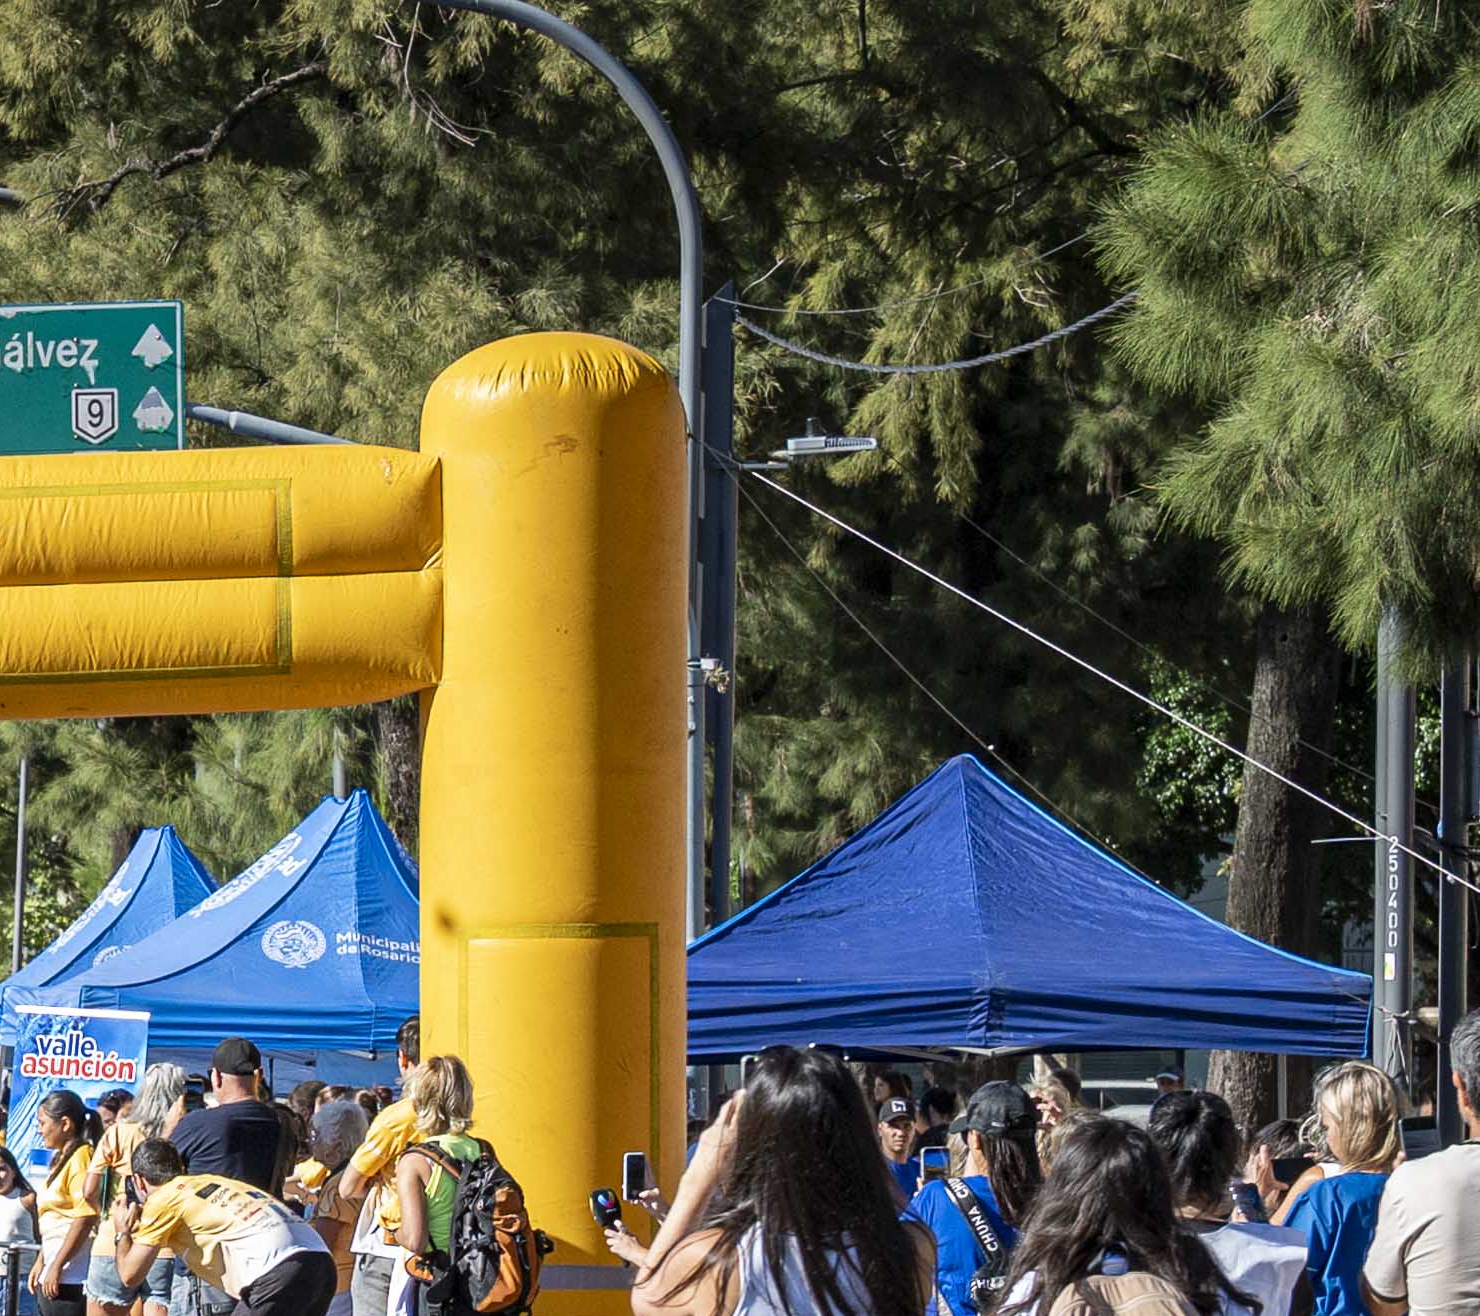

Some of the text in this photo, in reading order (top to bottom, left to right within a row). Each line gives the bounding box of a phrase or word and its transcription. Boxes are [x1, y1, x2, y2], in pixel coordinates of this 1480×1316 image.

[87, 399, 105, 428] 9
[1387, 836, 1400, 948] 250400
[336, 944, 358, 955] de
[38, 1033, 95, 1058] valle
[23, 1053, 134, 1079] asunción
[968, 1205, 999, 1252] CHUNA
